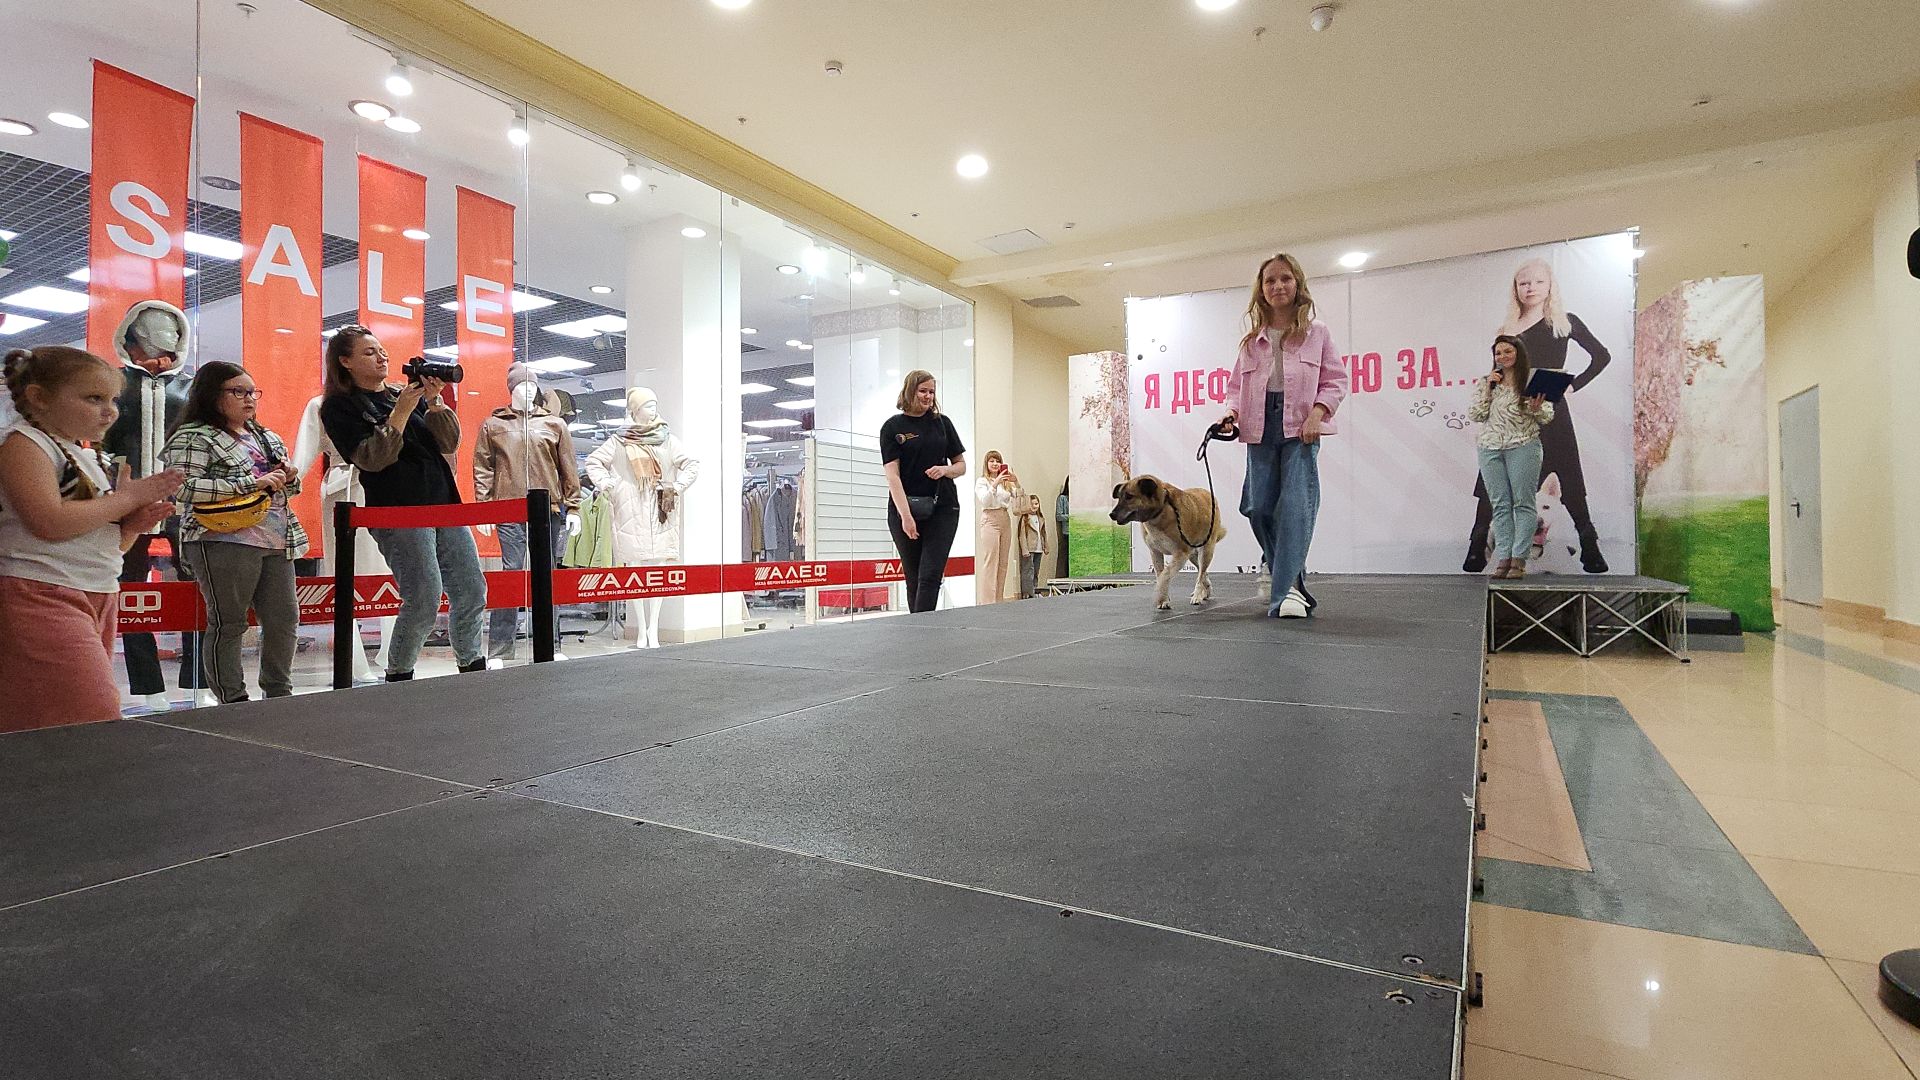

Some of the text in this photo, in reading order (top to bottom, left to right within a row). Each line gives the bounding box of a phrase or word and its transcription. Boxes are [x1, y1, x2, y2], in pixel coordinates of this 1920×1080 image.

[106, 181, 506, 336] SALE
[1145, 373, 1160, 409] Я
[600, 570, 686, 589] АЛЕФ
[769, 565, 826, 580] АЛЕФ
